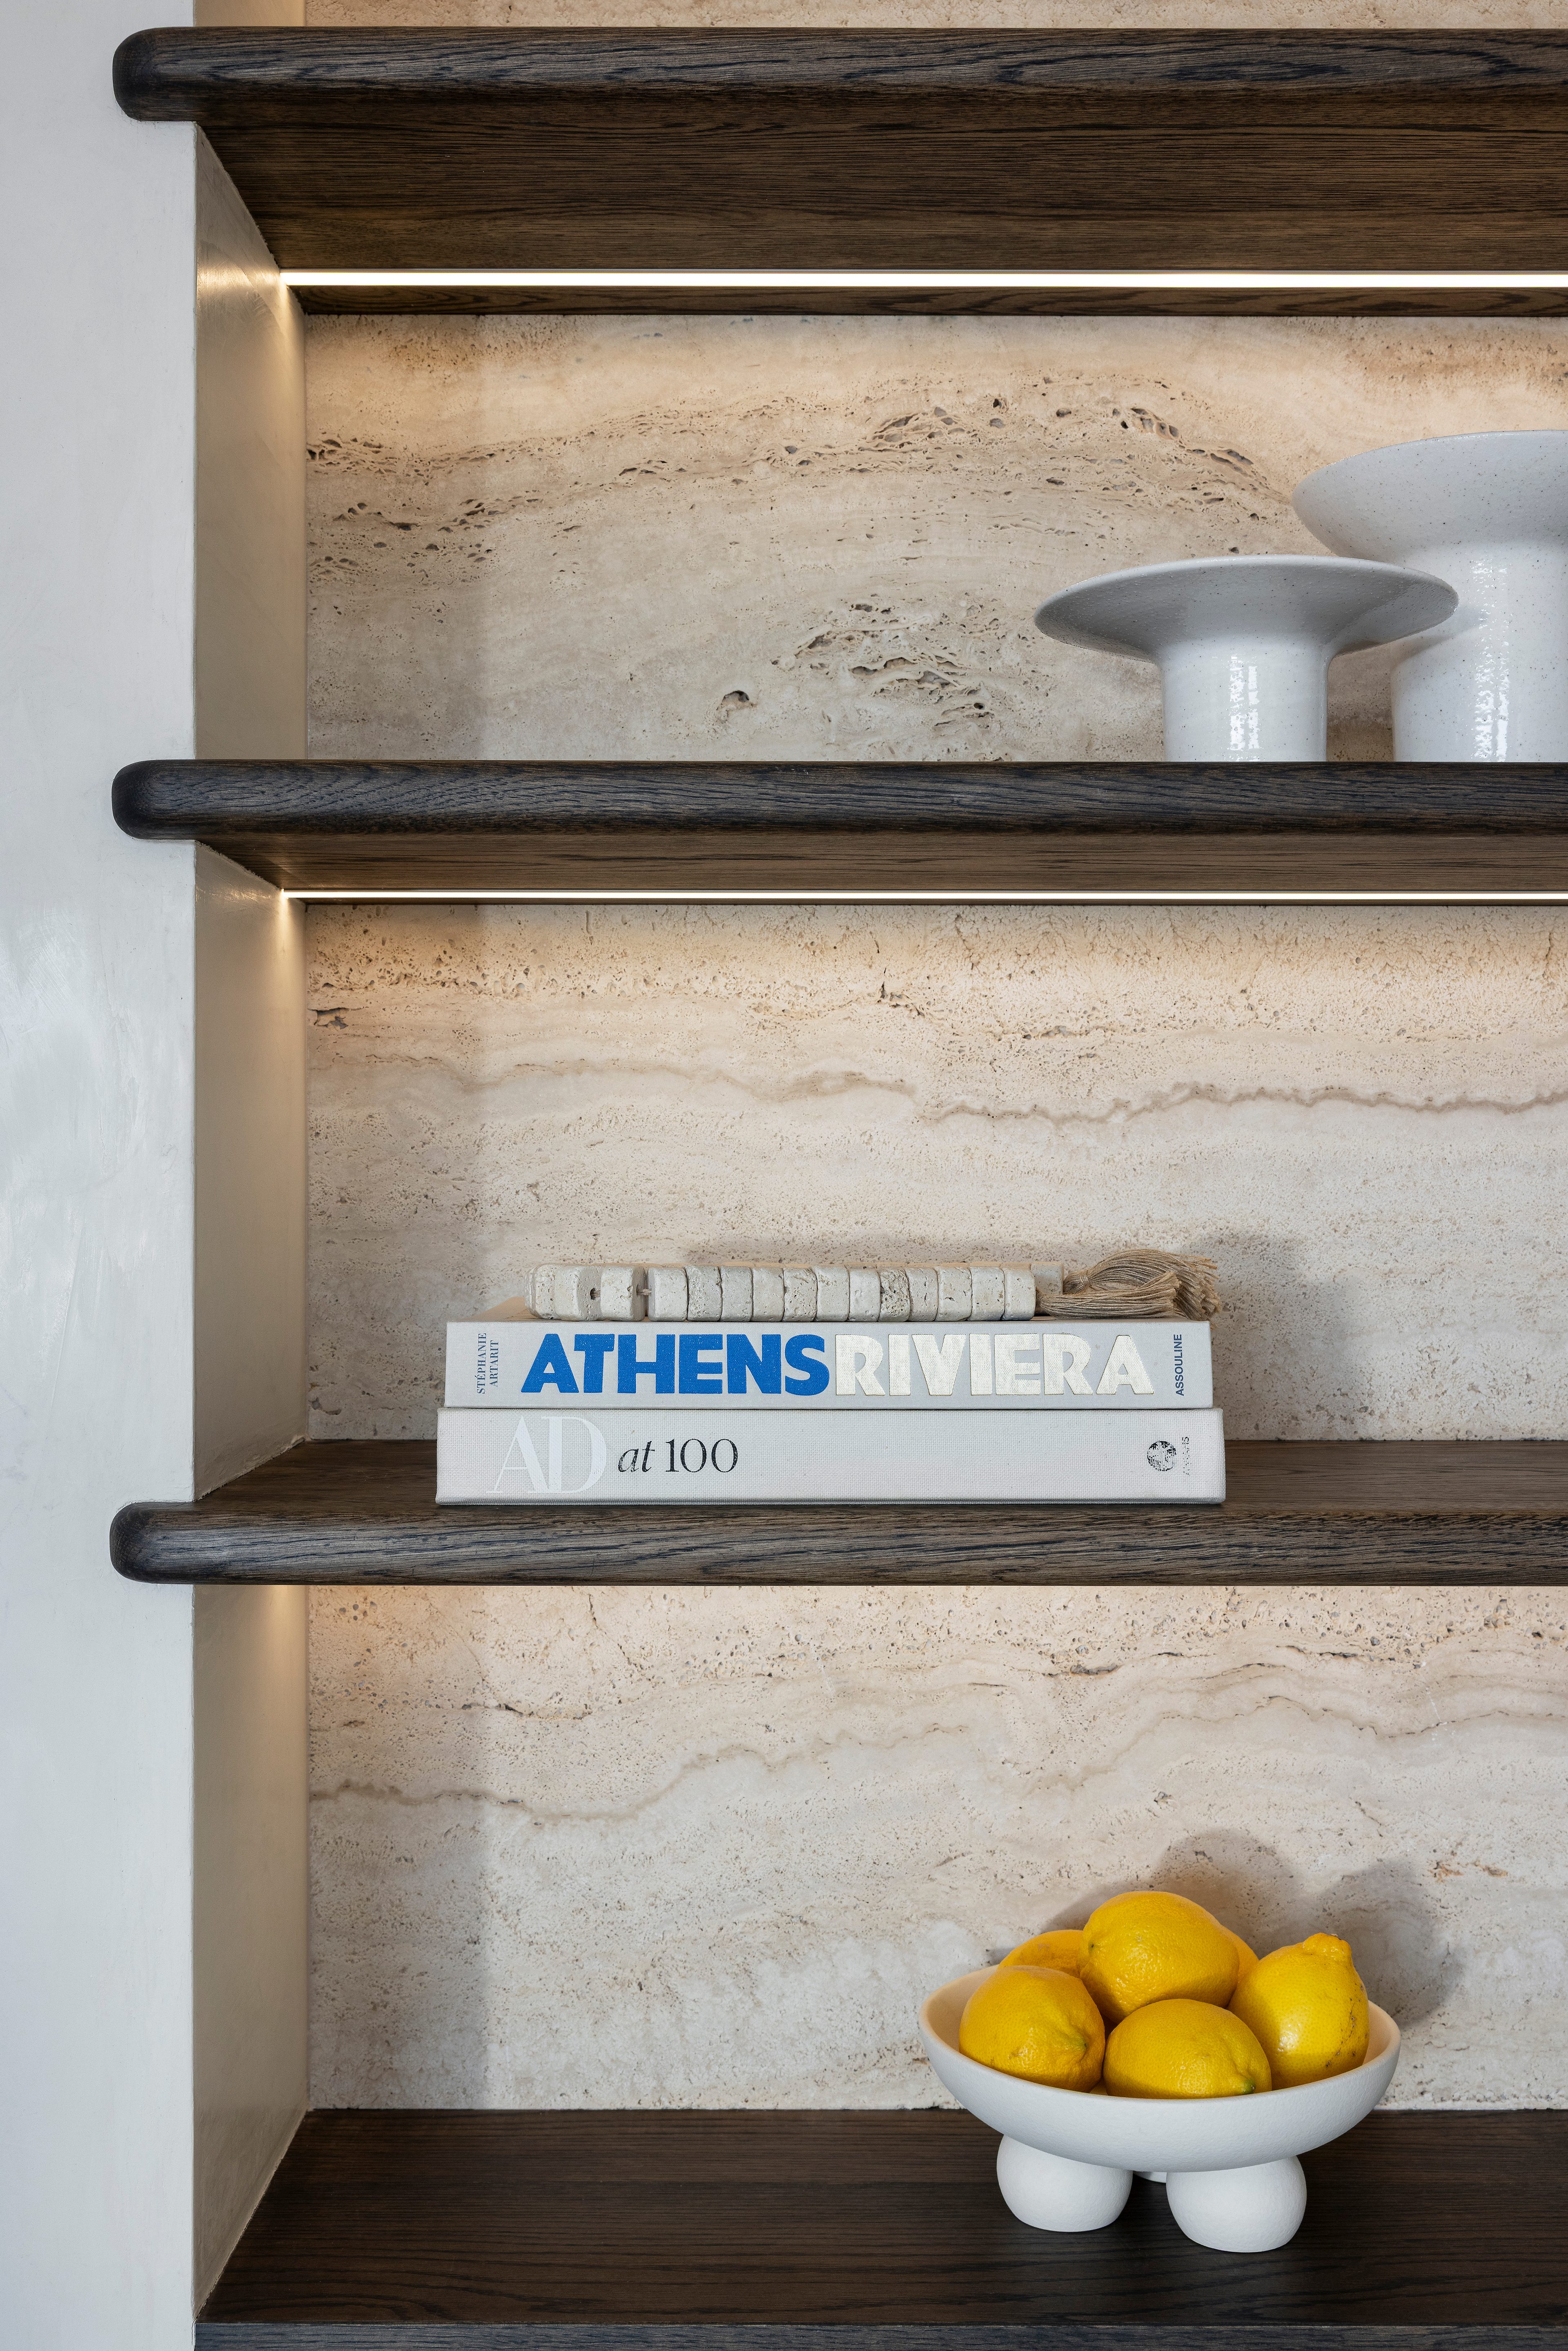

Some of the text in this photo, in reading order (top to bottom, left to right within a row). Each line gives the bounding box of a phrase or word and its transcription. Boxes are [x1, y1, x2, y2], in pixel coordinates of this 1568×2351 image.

[474, 1333, 486, 1394] STÉPHANIE
[489, 1340, 499, 1387] ARTARIT
[521, 1333, 1155, 1396] ATHENS RIVIERA
[1173, 1334, 1185, 1396] ASSOULINE
[486, 1416, 738, 1494] AD at 100
